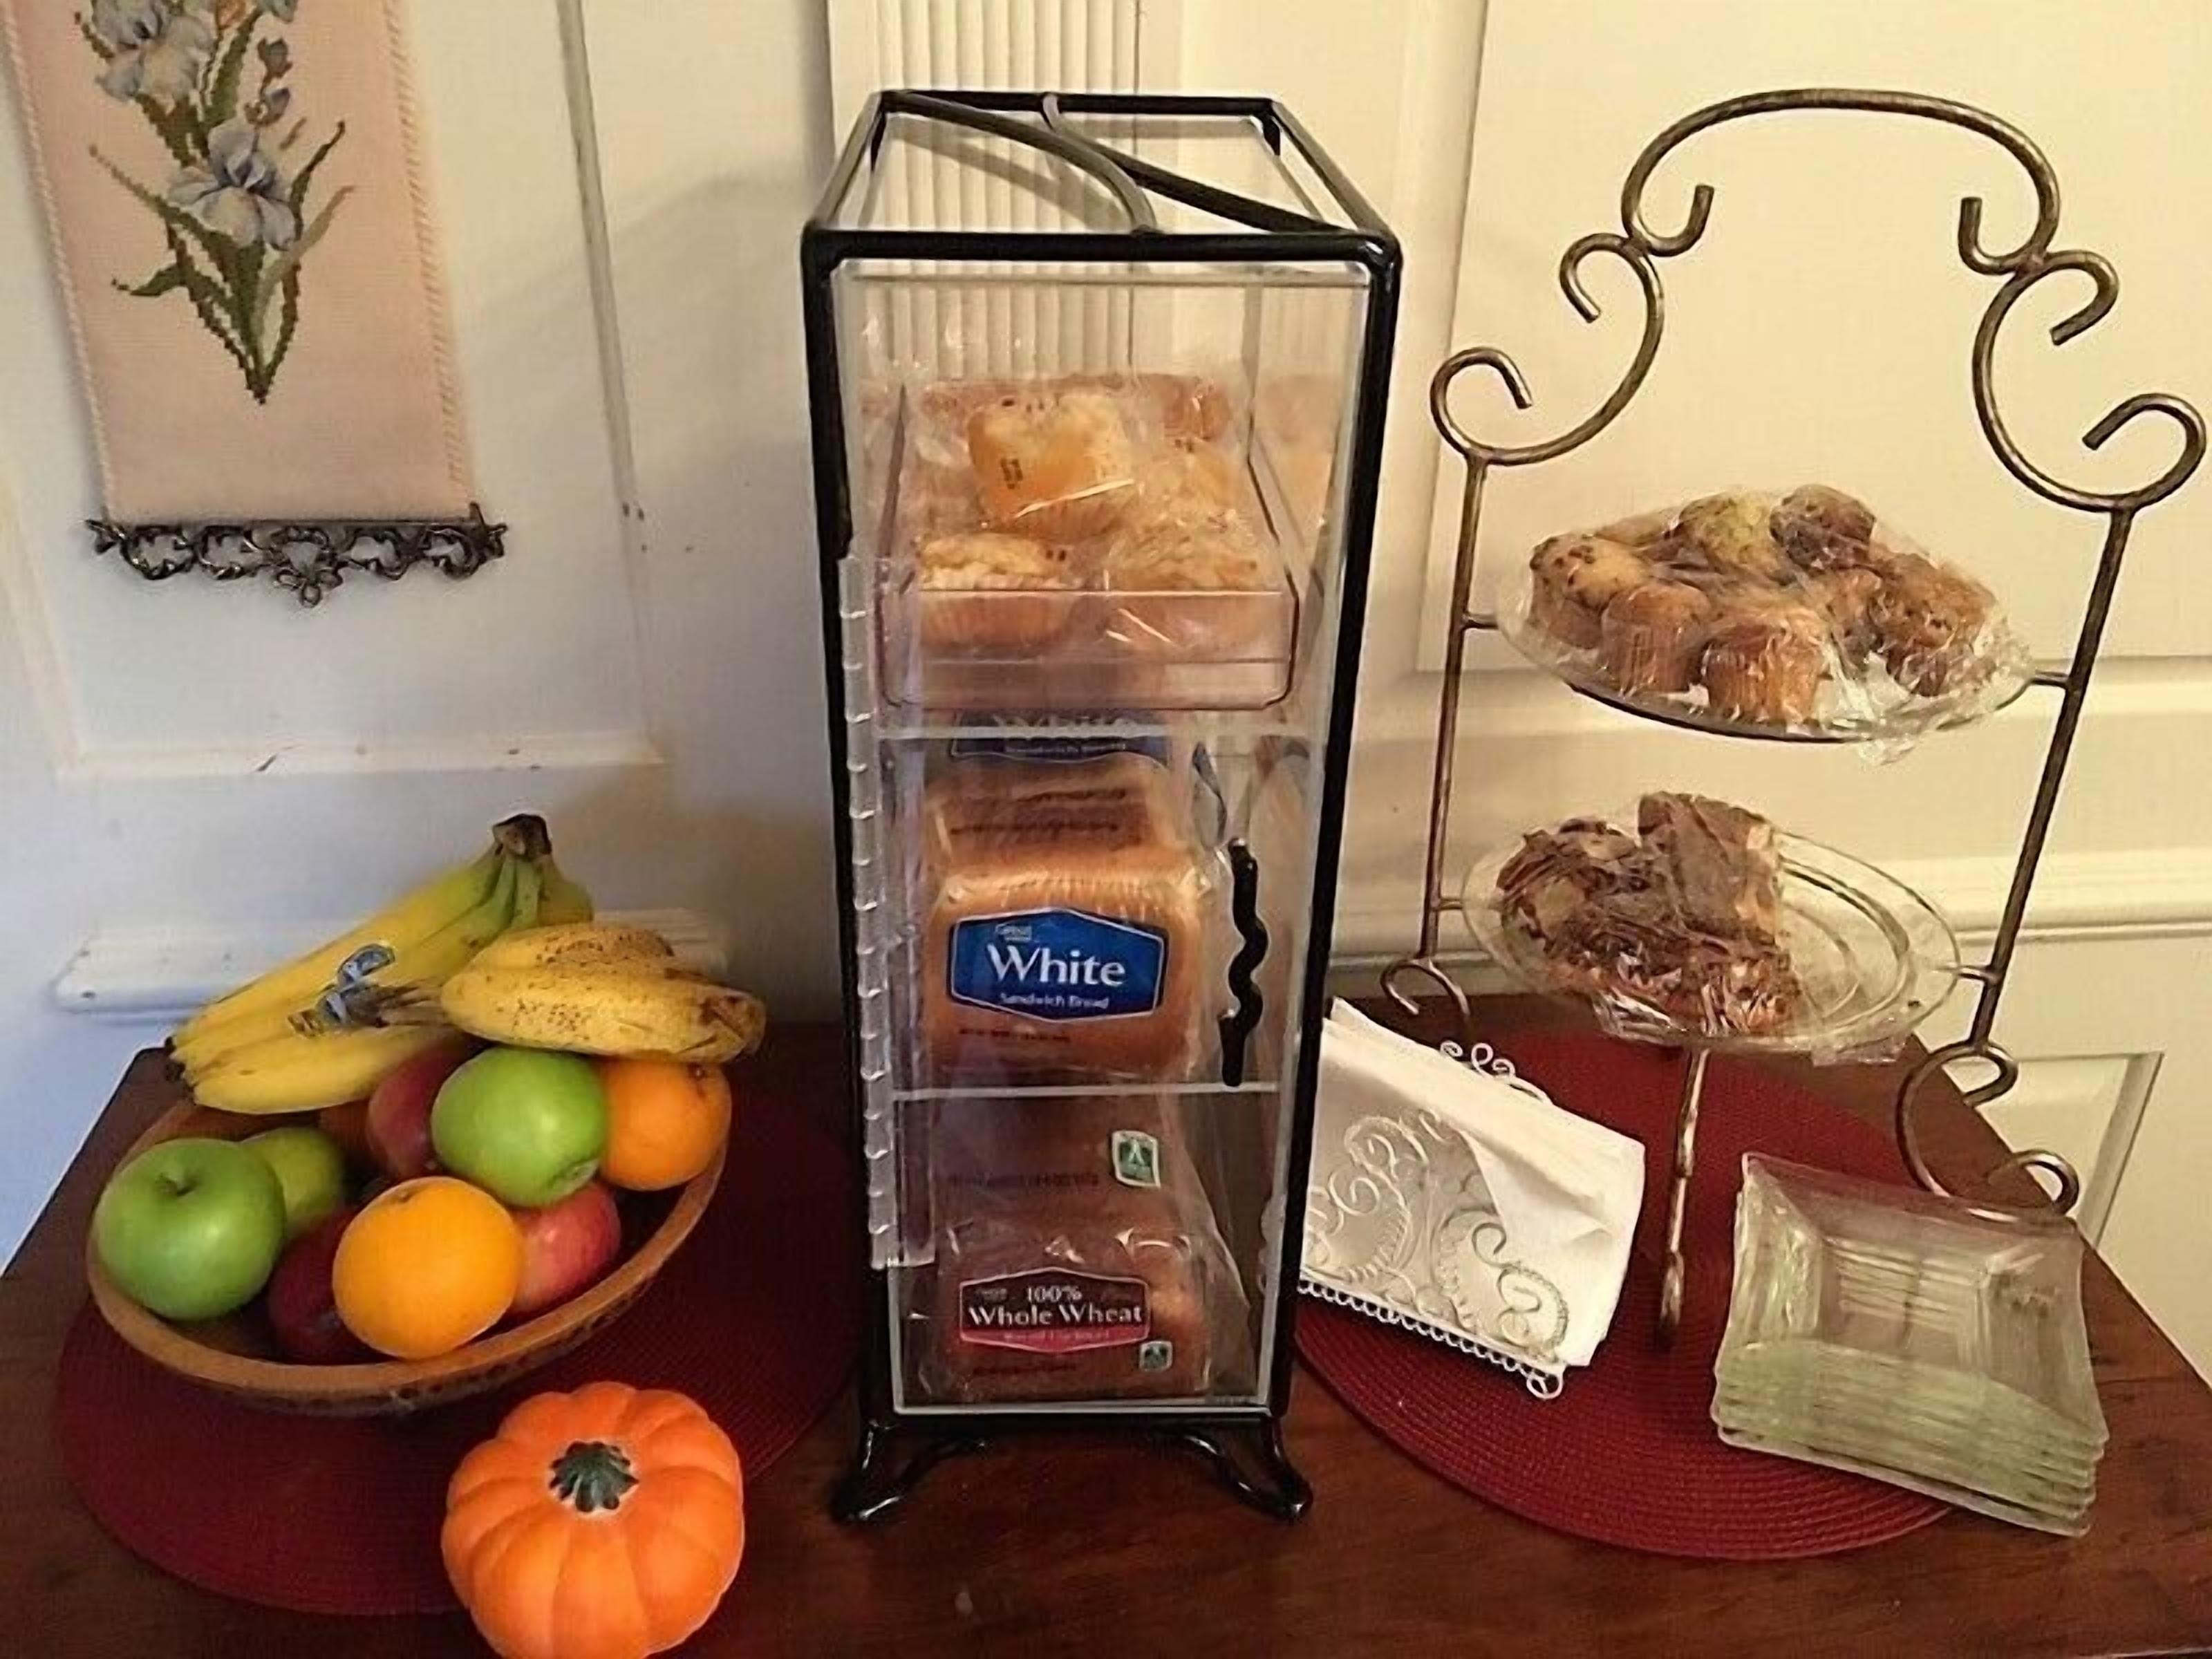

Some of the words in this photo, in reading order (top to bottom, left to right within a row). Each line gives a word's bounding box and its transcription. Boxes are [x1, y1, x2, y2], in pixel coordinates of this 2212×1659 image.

[986, 943, 1126, 988] White
[1027, 1285, 1082, 1303] 100%
[969, 1304, 1053, 1325] Whole
[1058, 1302, 1143, 1324] Wheat
